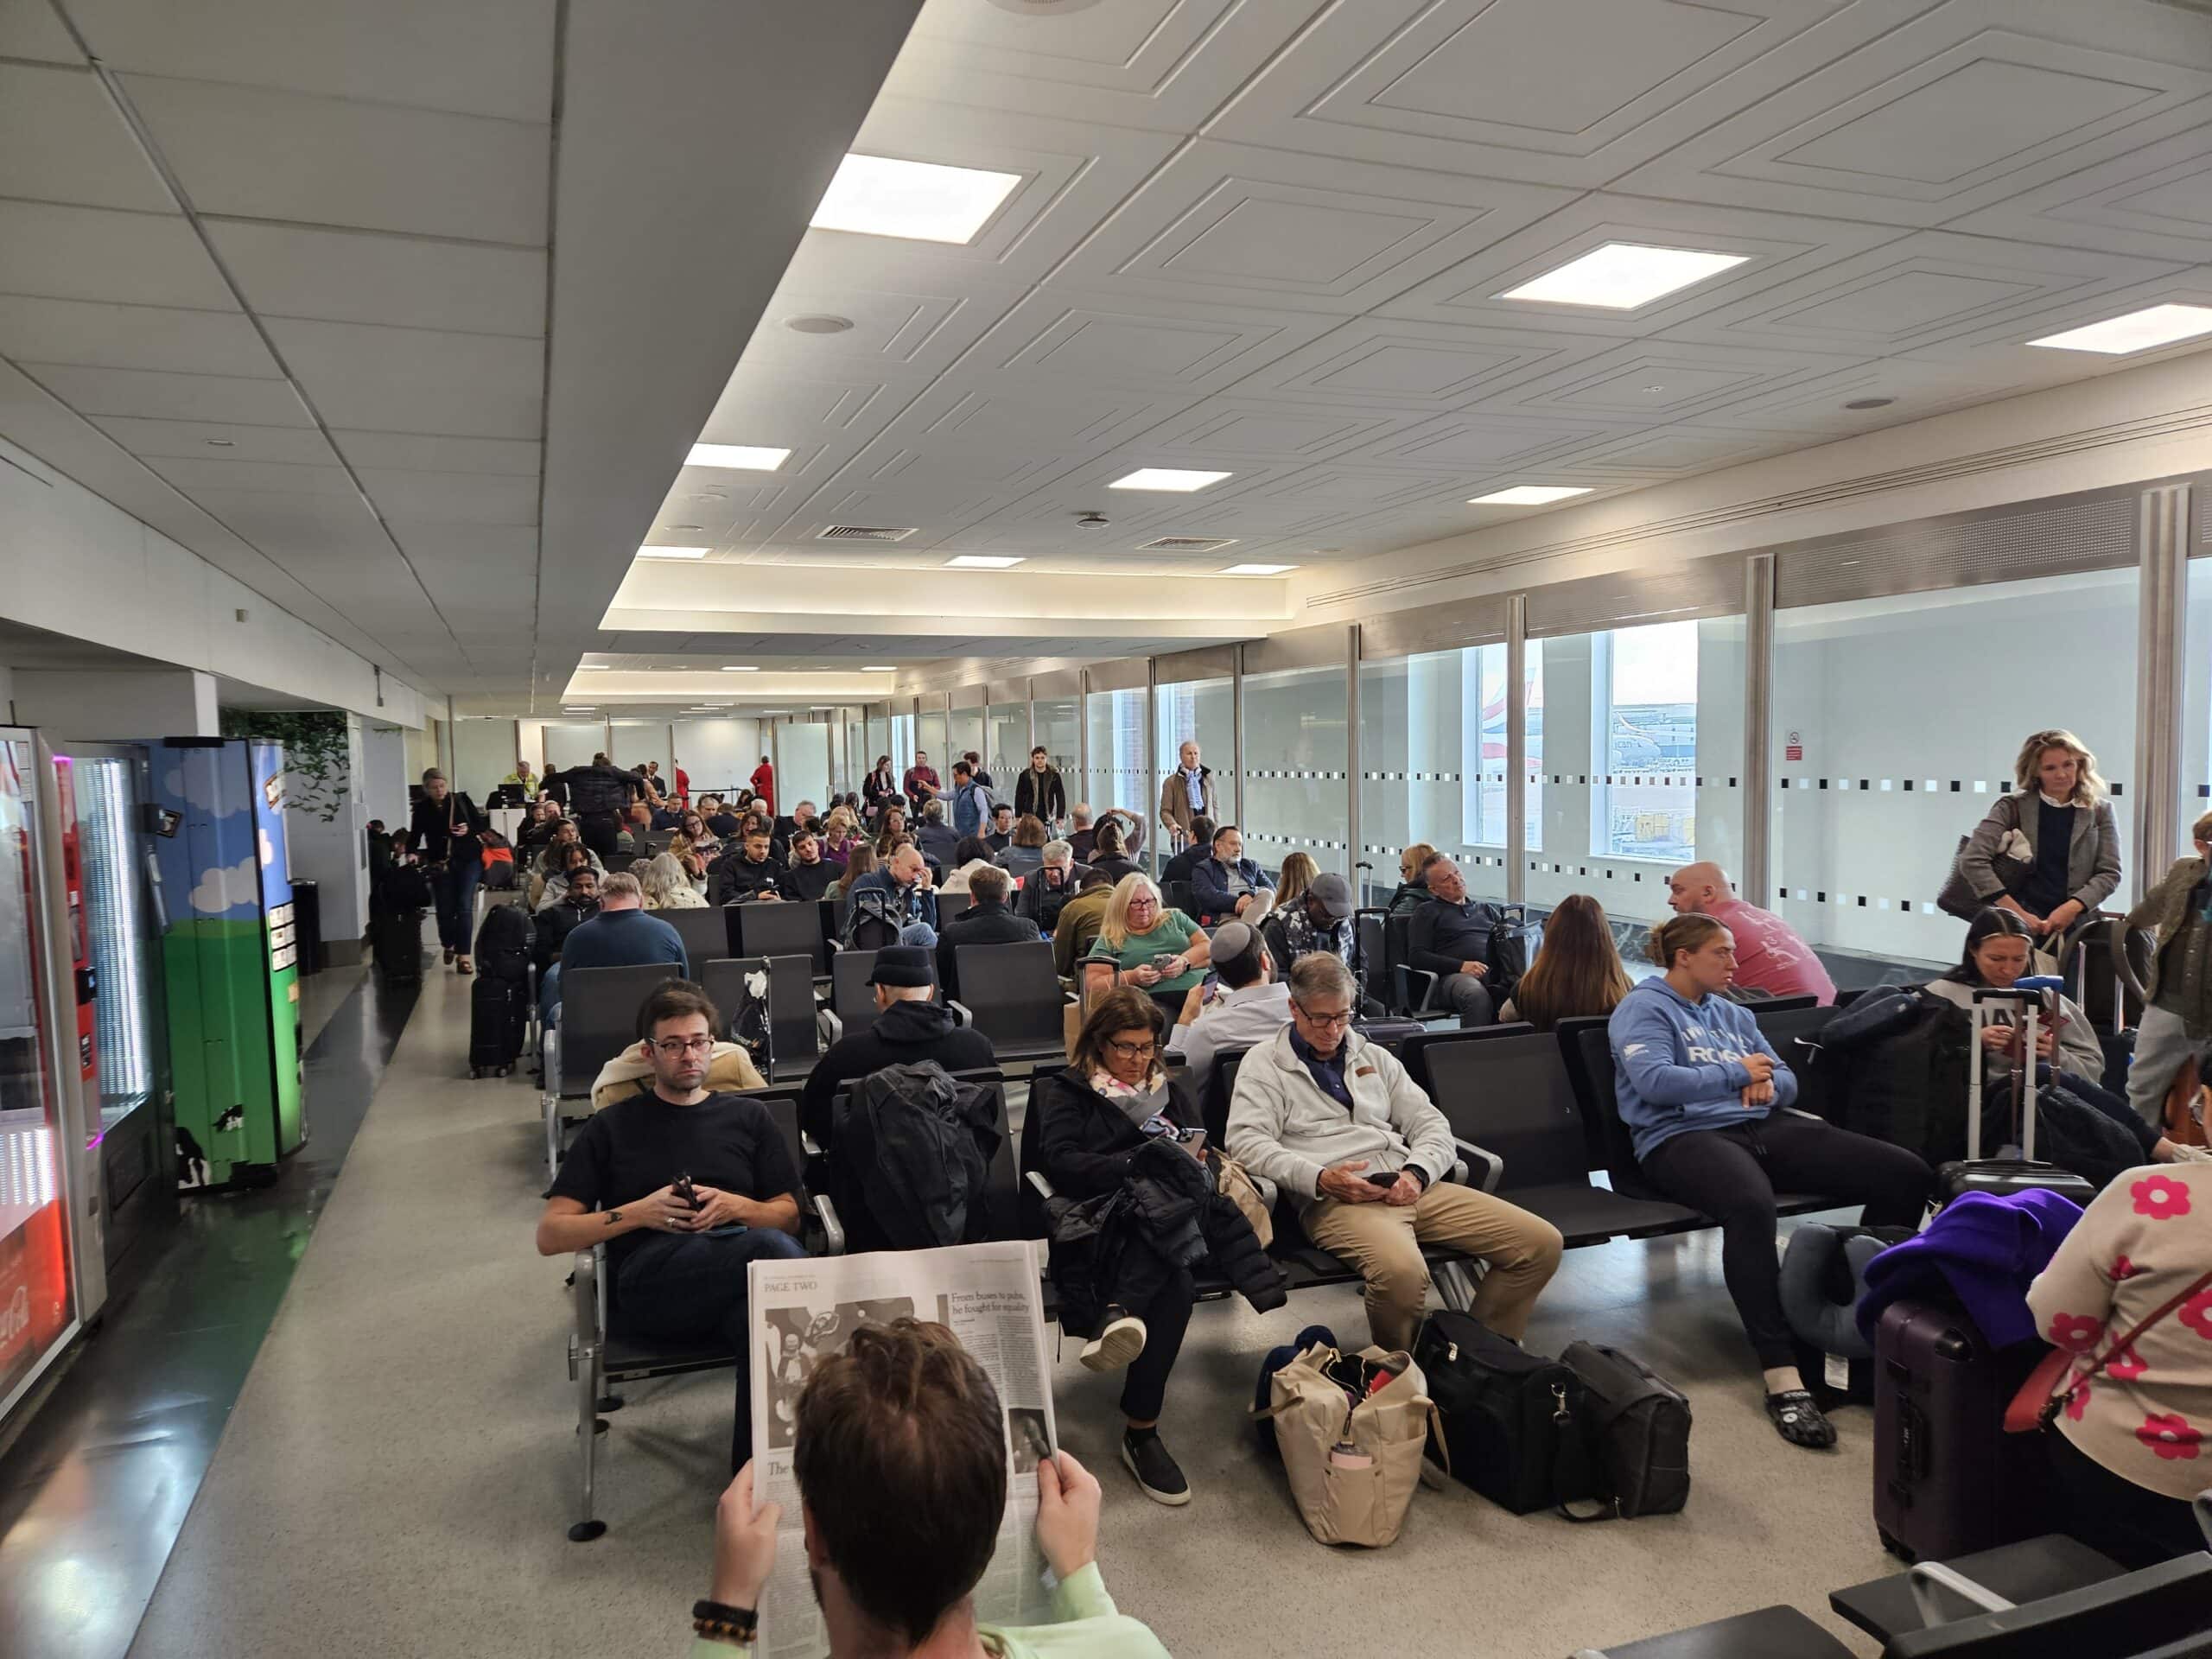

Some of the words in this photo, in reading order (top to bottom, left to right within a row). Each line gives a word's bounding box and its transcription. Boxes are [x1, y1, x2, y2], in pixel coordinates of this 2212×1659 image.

[764, 1282, 790, 1293] PAGE
[793, 1281, 817, 1292] TWO
[951, 1292, 975, 1303] From
[952, 1305, 963, 1314] he
[964, 1302, 990, 1314] fought
[991, 1301, 1001, 1312] for
[1002, 1301, 1030, 1313] equality
[766, 1462, 789, 1476] The
